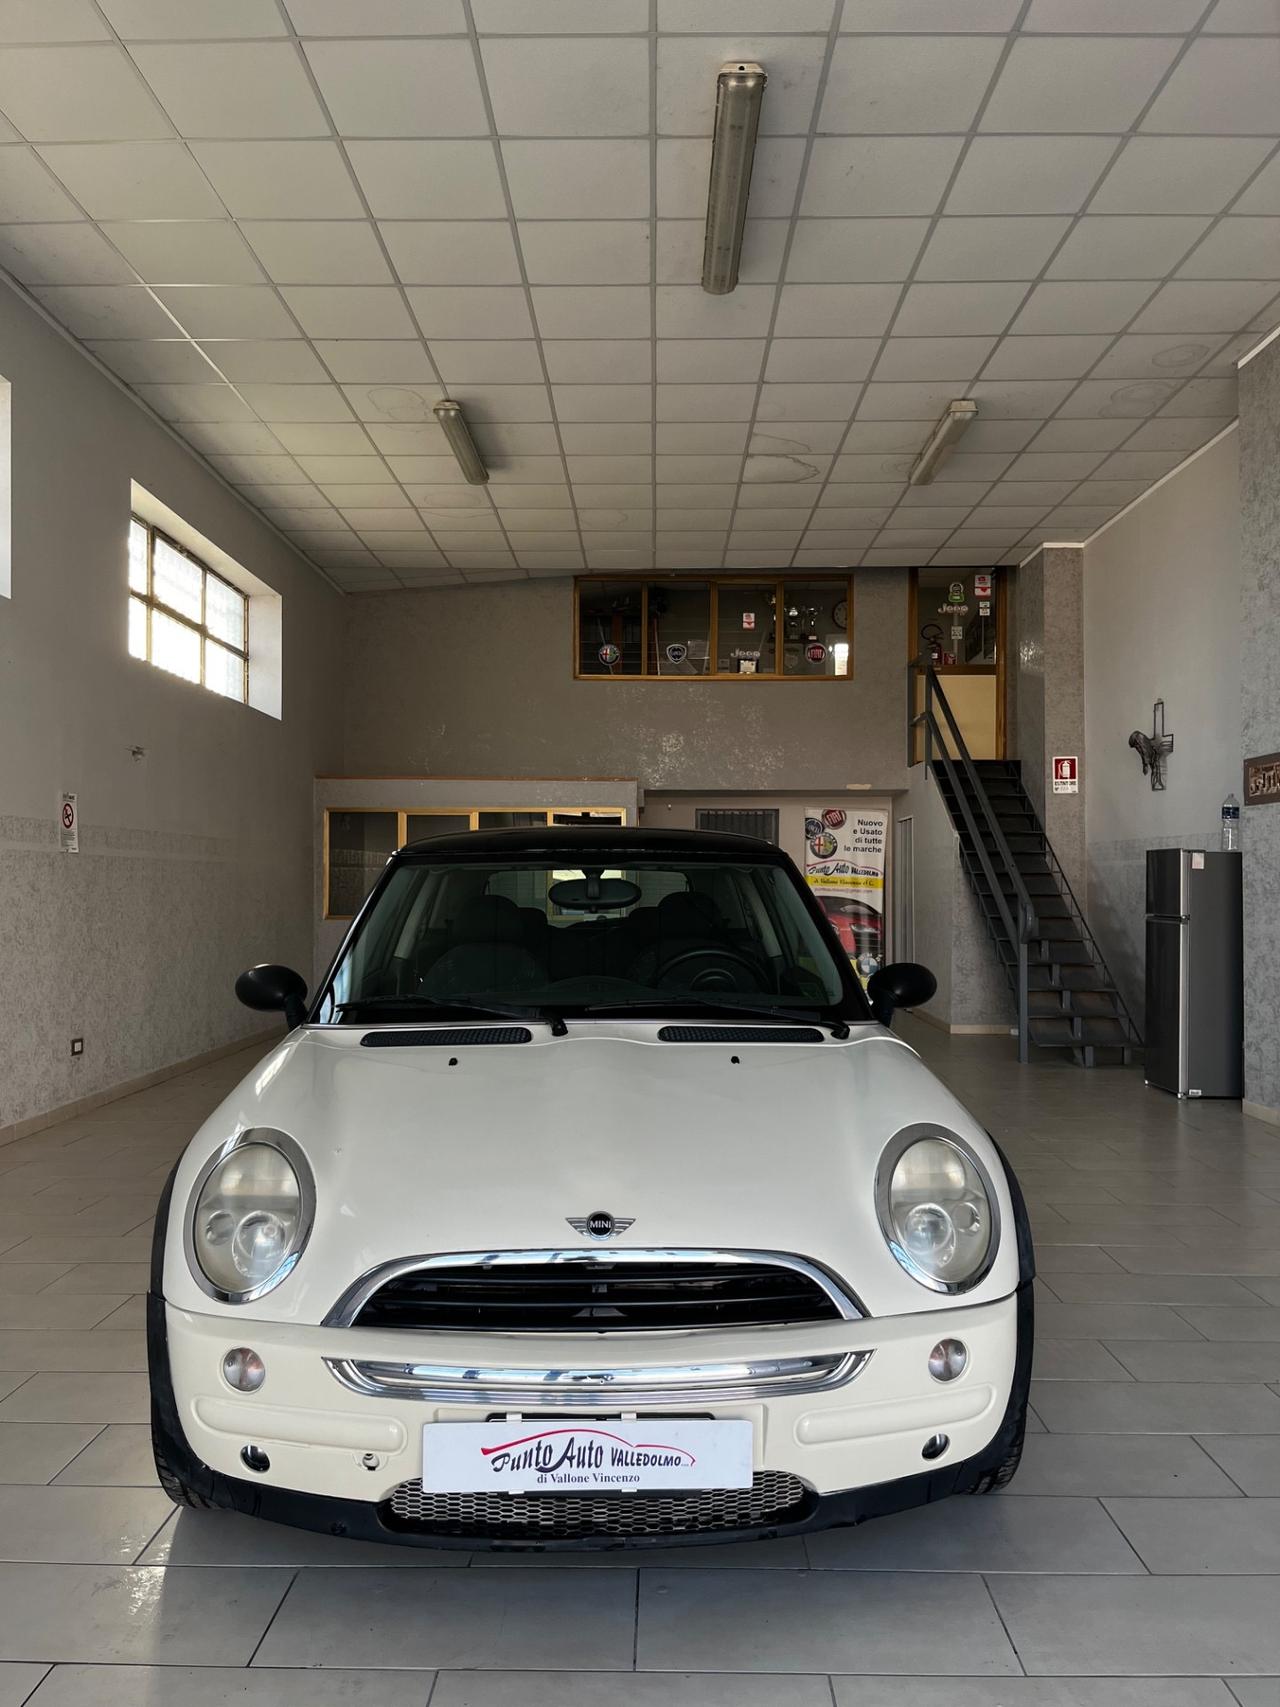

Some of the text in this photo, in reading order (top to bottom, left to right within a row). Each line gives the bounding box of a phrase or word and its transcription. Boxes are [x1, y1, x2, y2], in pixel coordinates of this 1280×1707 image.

[826, 810, 842, 825] FIAT
[857, 819, 883, 827] Nuovo
[860, 828, 883, 836] Usato
[864, 837, 882, 845] tutte
[853, 846, 882, 854] marche
[589, 1220, 612, 1228] MINI
[491, 1436, 682, 1473] Punto Auto VALLEDOLMO
[537, 1472, 640, 1484] di Vallone Vincenzo
